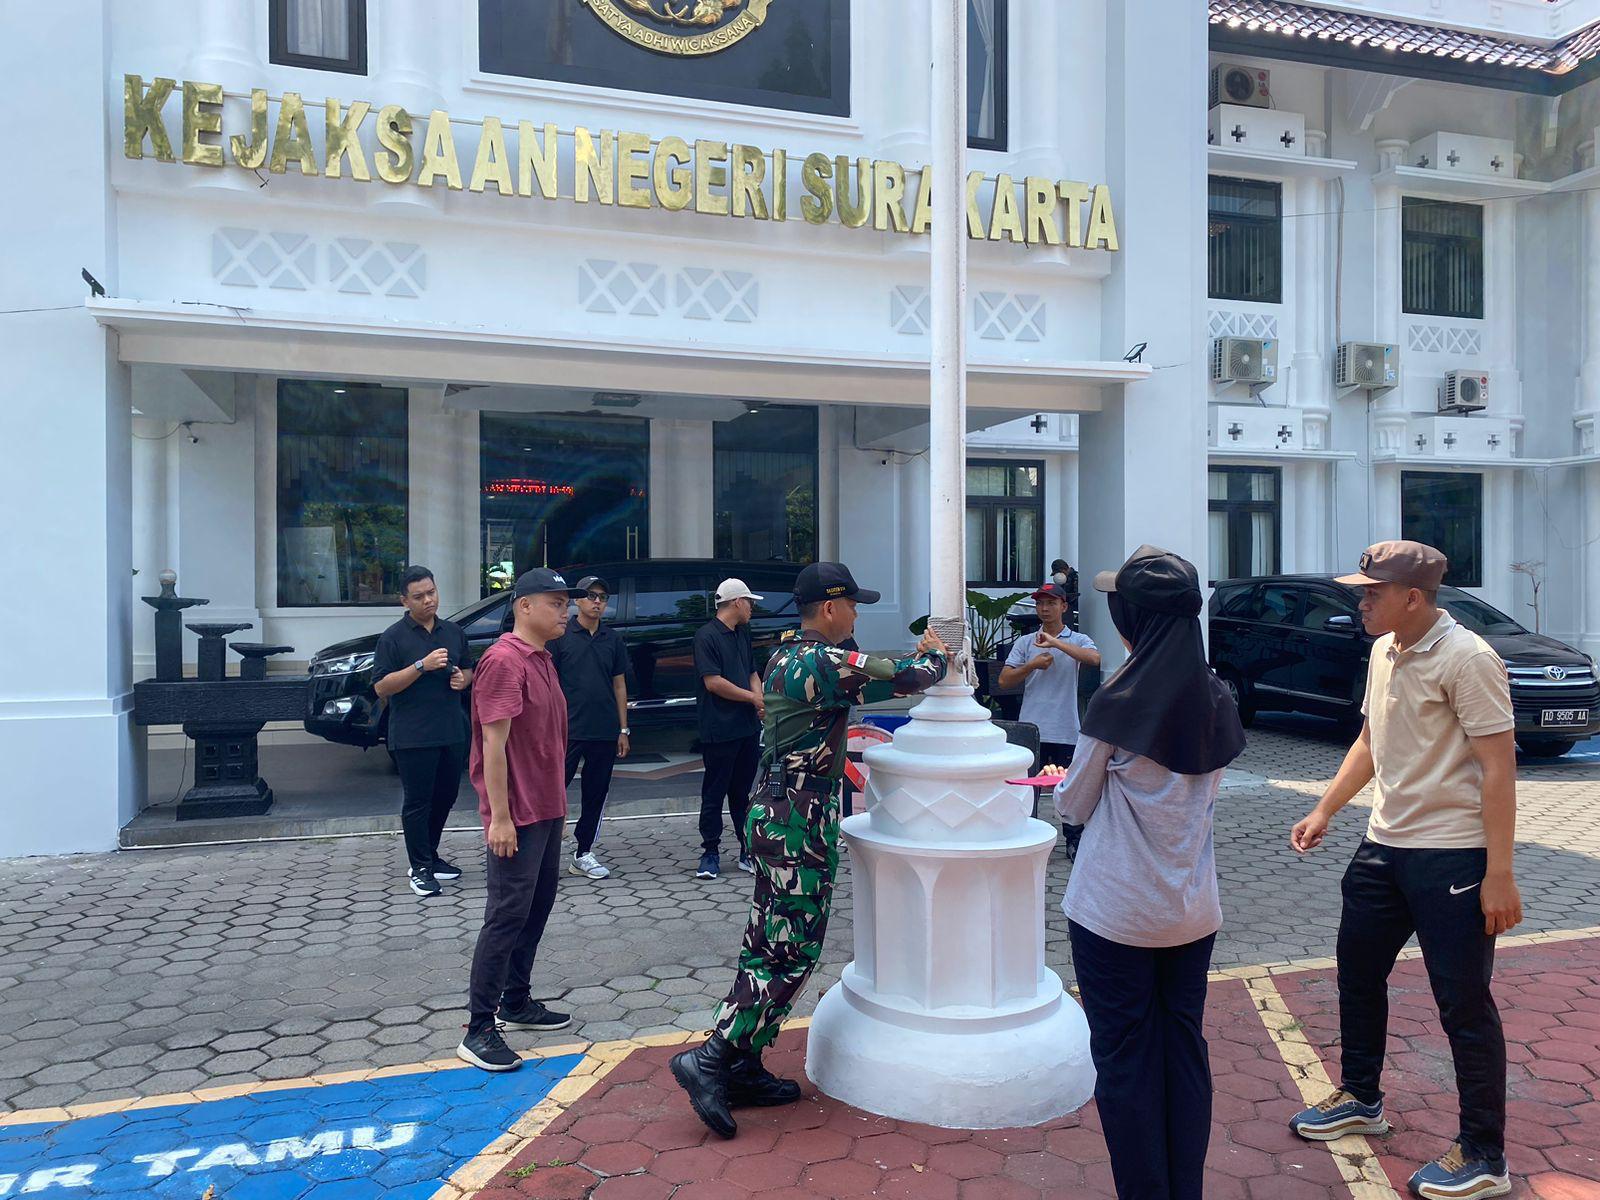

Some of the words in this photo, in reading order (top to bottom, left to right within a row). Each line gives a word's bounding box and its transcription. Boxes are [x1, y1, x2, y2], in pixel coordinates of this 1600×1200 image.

[593, 0, 631, 35] SATYA
[633, 28, 669, 49] ADHI
[669, 17, 753, 52] WICAKSANA
[124, 74, 558, 199] KEJAKSAAN
[574, 126, 786, 222] NEGERI
[1545, 711, 1554, 721] AD
[131, 1121, 420, 1177] TAMU
